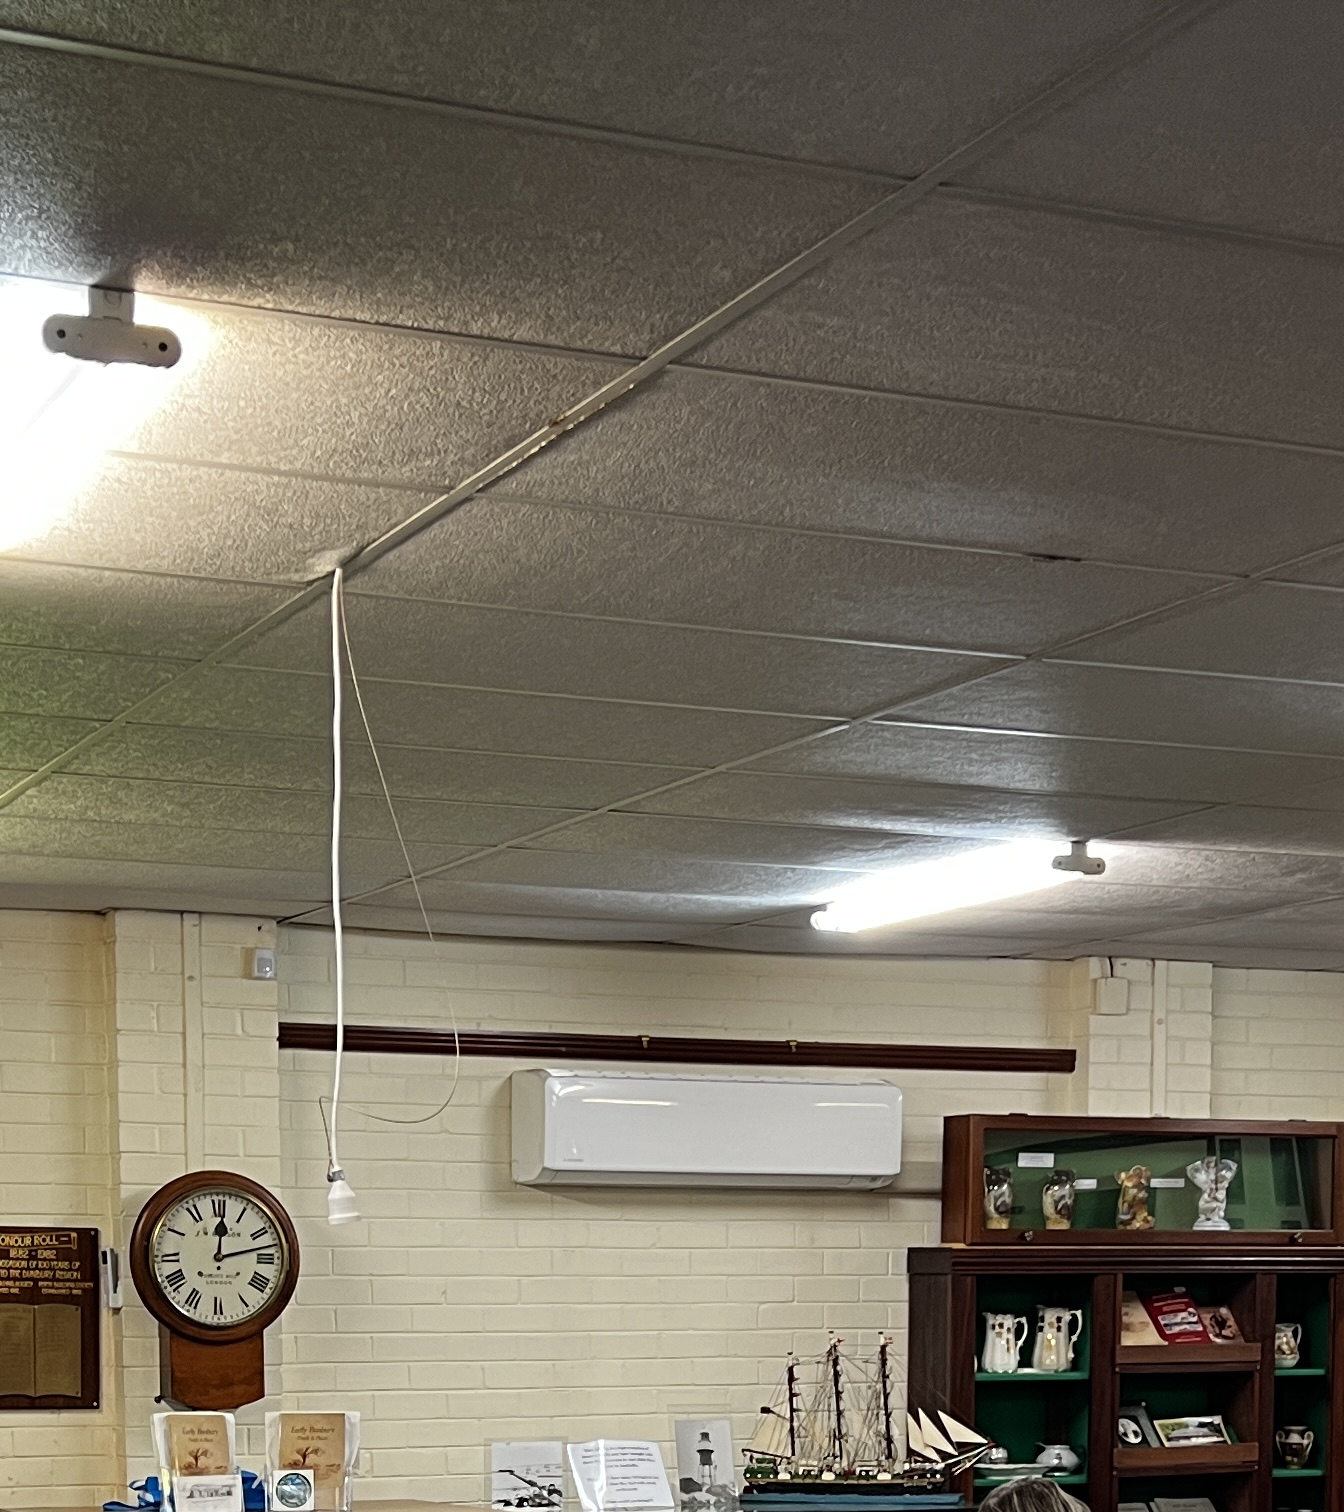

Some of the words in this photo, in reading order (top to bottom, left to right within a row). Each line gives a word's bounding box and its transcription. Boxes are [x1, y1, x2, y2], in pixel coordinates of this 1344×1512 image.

[34, 1234, 58, 1246] ROLL
[37, 1249, 57, 1259] 1982
[29, 1259, 37, 1269] OF
[38, 1260, 50, 1269] 100
[50, 1260, 70, 1269] YEARS
[0, 1268, 8, 1277] TO
[9, 1269, 21, 1278] THE
[22, 1269, 54, 1279] BUNBURY
